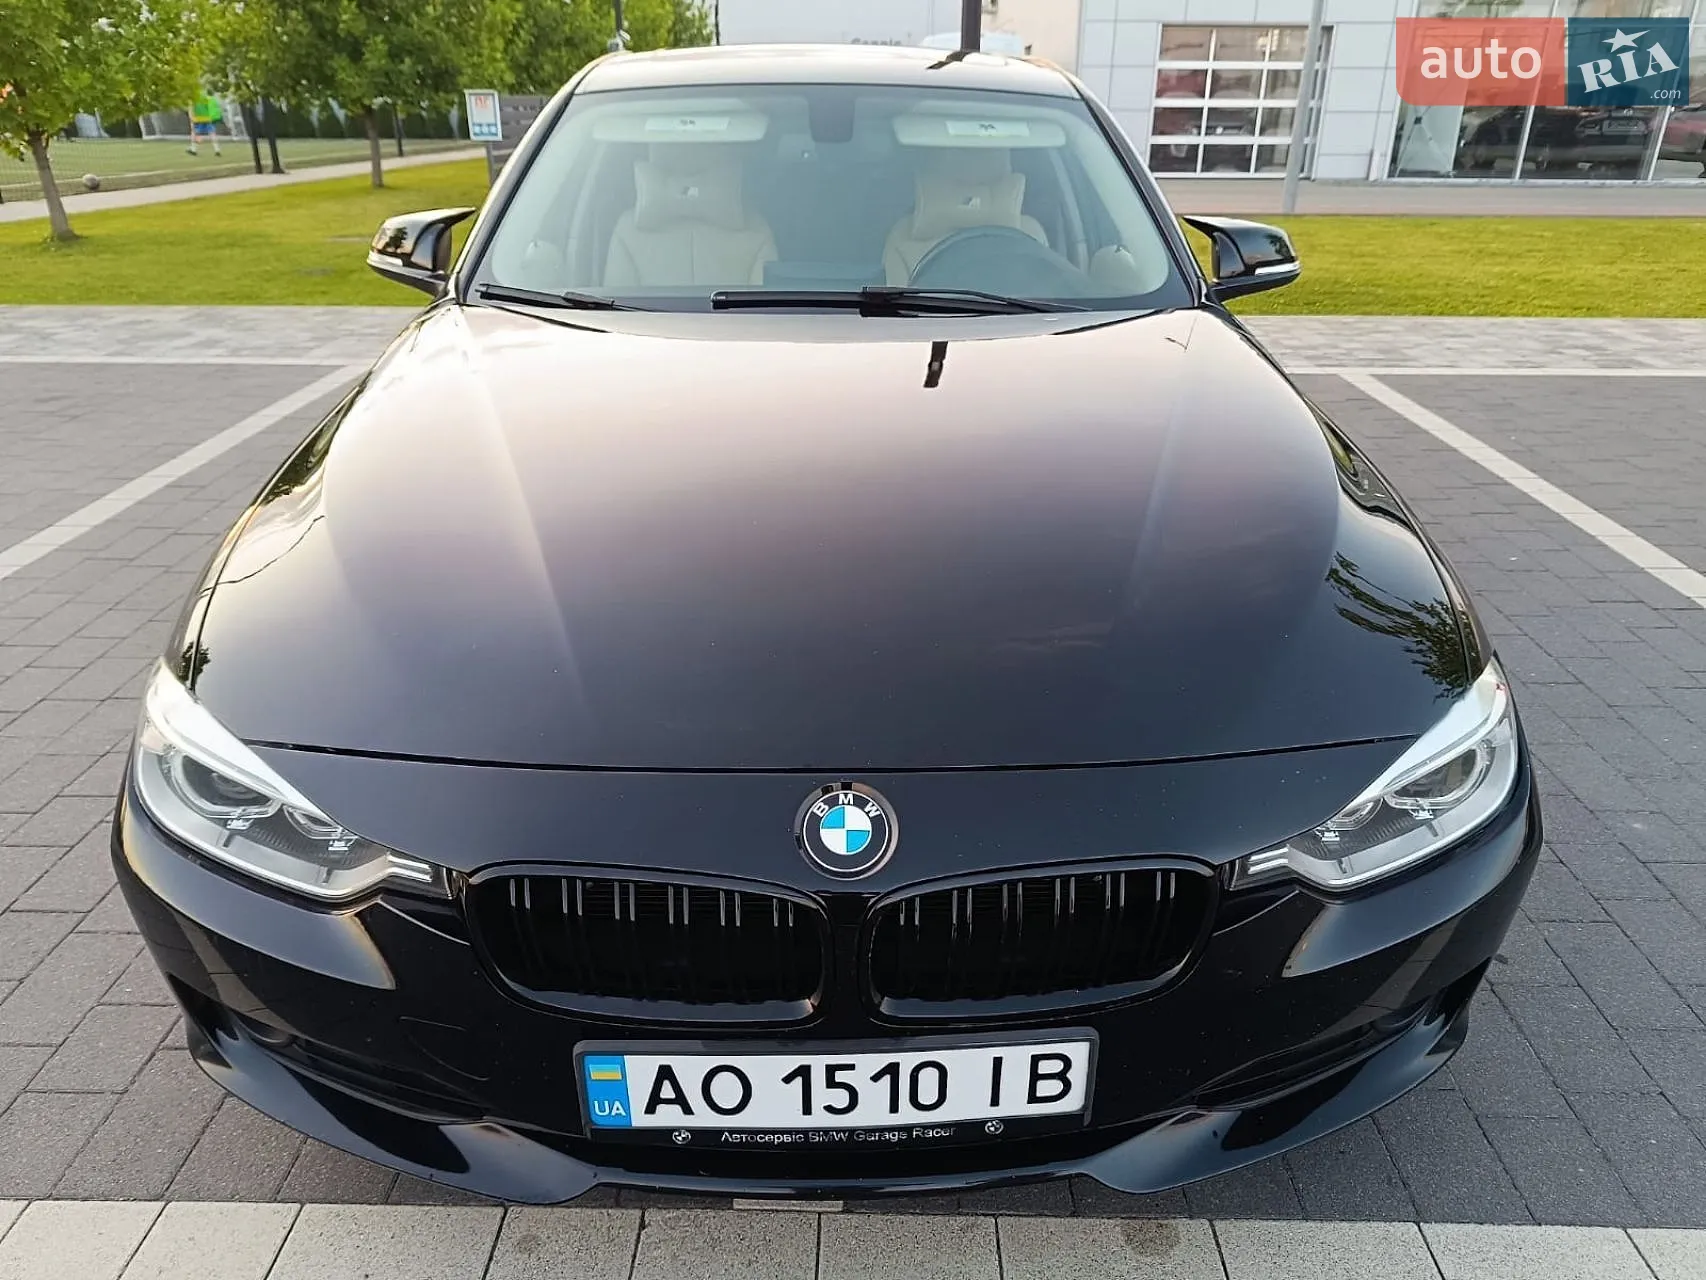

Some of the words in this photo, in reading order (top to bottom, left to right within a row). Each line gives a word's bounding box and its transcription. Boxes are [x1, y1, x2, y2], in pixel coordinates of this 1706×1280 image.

[813, 793, 880, 818] BMW
[643, 1063, 753, 1116] AO
[781, 1060, 949, 1116] 1510
[594, 1100, 626, 1116] UA
[808, 1130, 849, 1143] BMW
[853, 1129, 908, 1143] Garage
